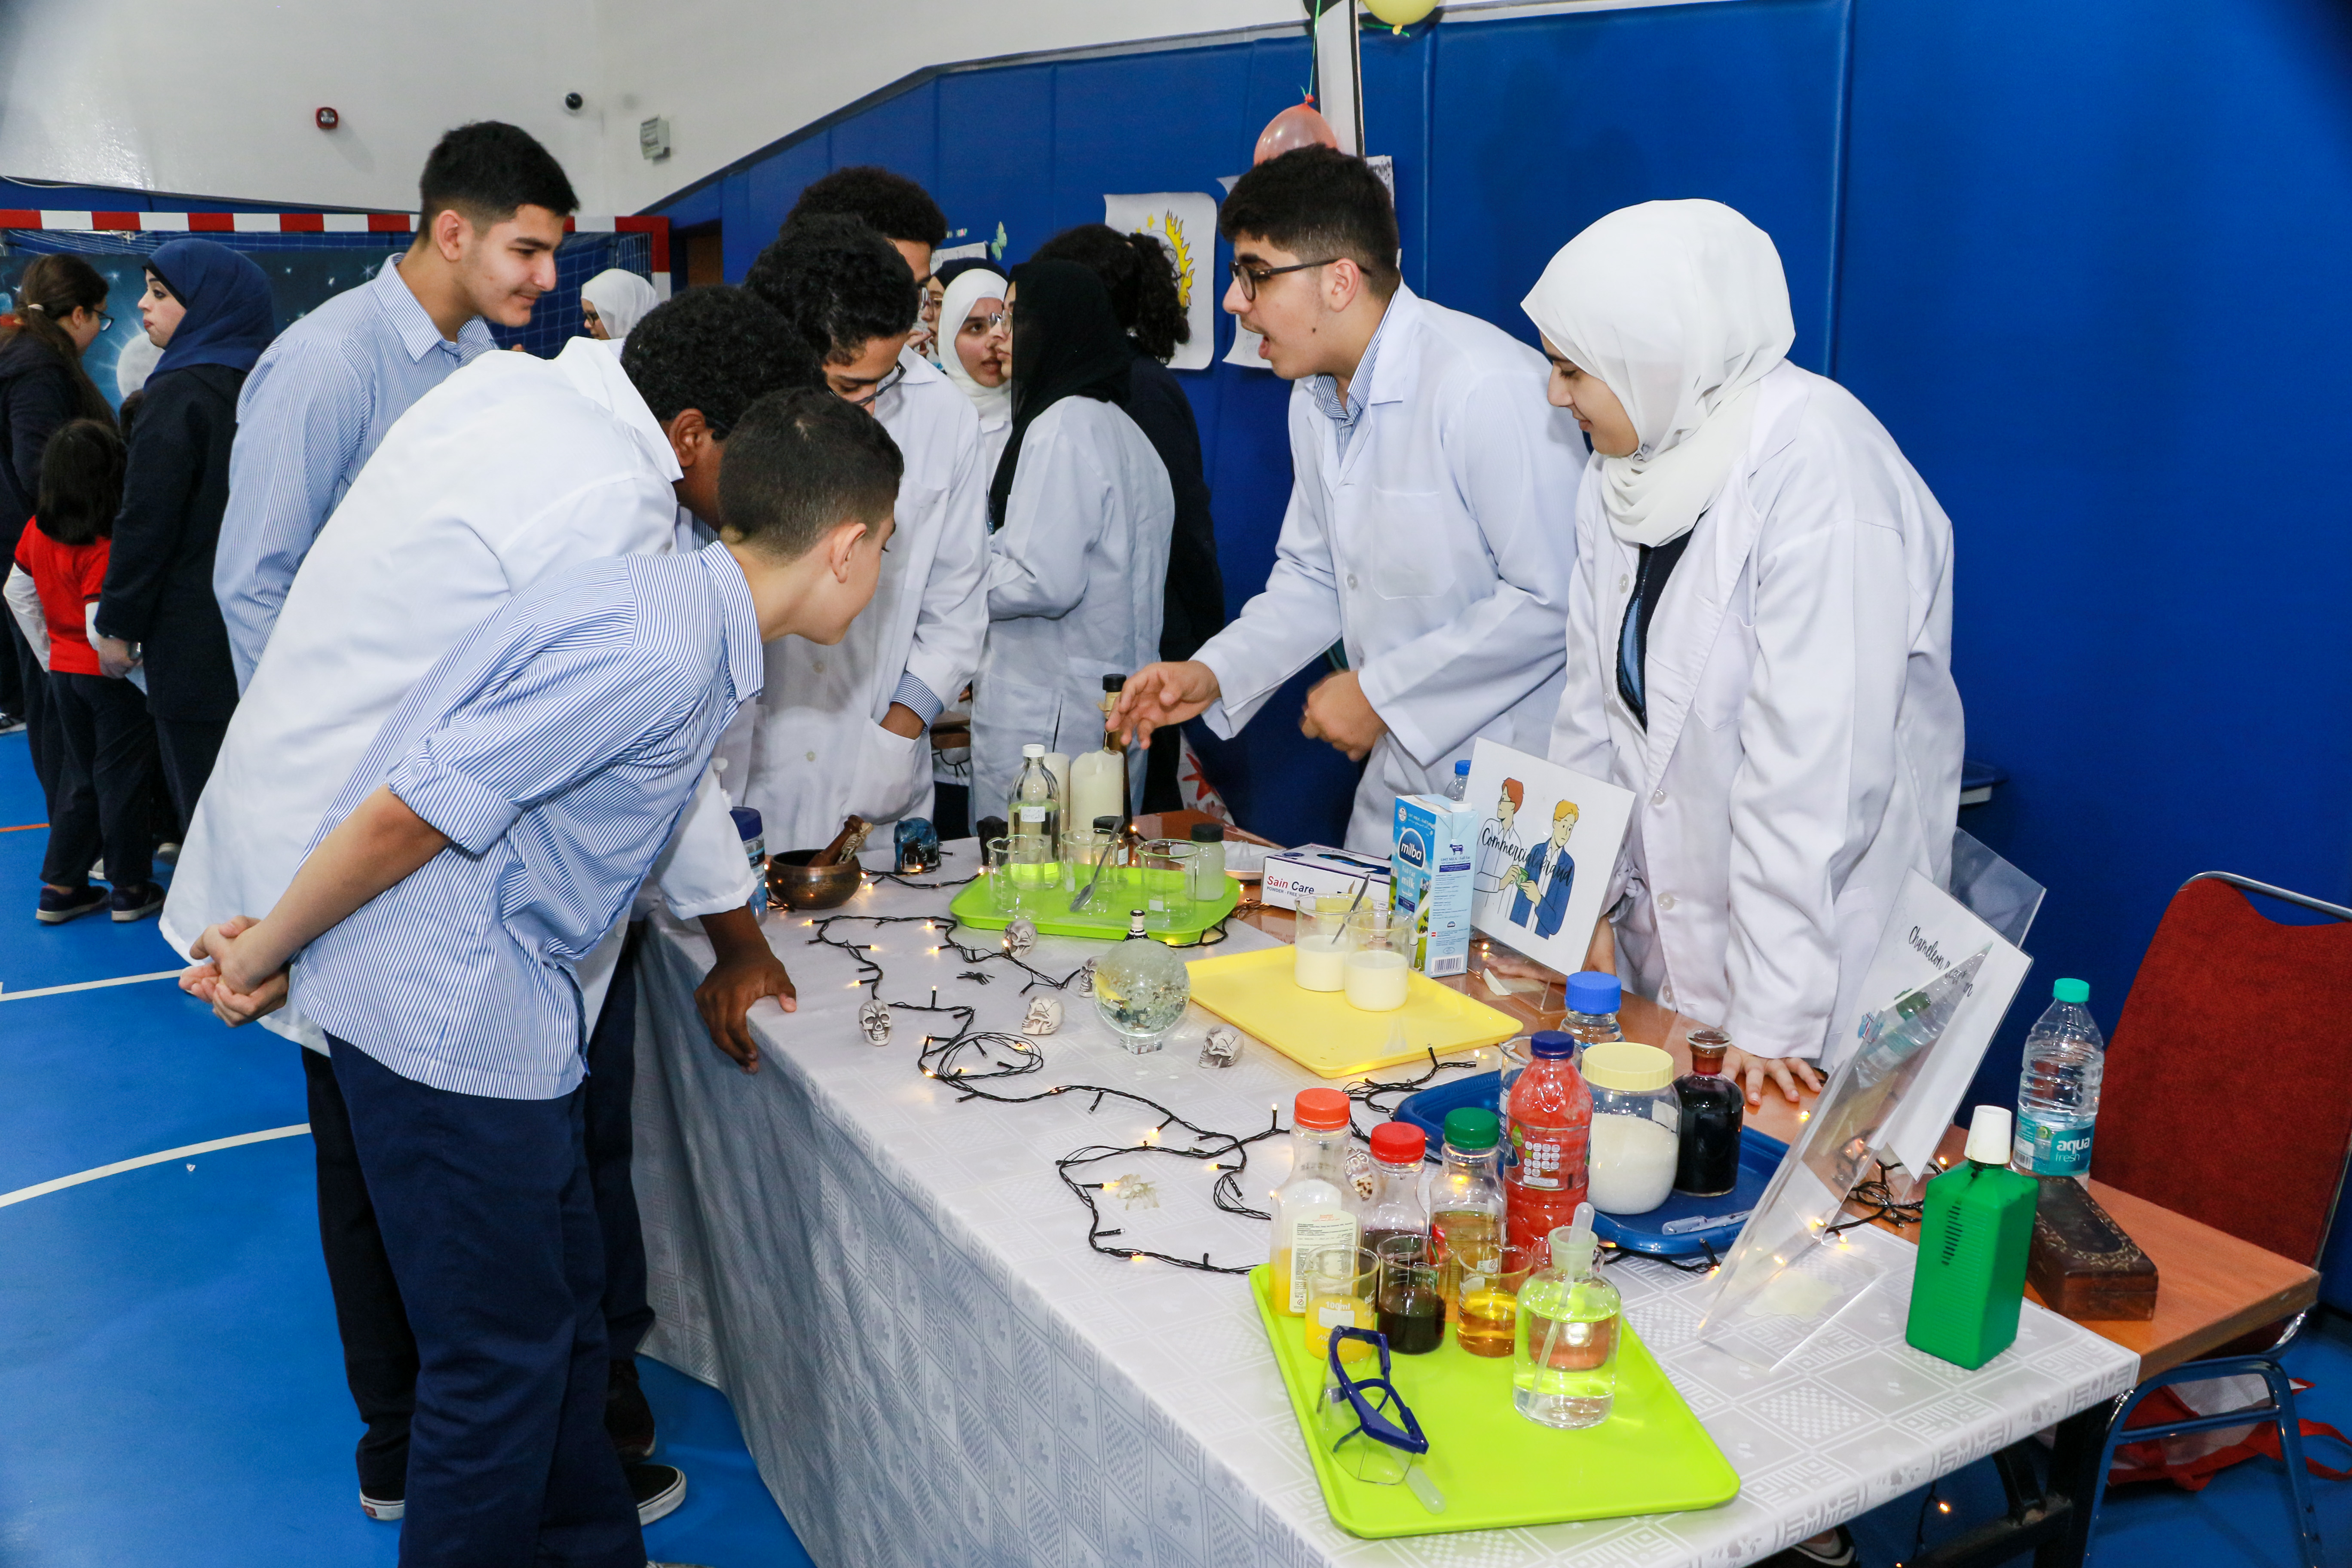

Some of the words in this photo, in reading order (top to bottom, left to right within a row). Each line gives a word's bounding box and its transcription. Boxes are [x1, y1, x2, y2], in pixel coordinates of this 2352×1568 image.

[1401, 843, 1422, 860] milba
[1482, 828, 1540, 867] Commercial
[1267, 876, 1288, 888] Sain
[1292, 881, 1314, 894] Care
[1402, 876, 1415, 890] milk
[1909, 926, 1944, 970] Chameleon
[2056, 1137, 2090, 1154] aqua
[2055, 1152, 2080, 1162] fresh
[1326, 1301, 1351, 1310] 100ml
